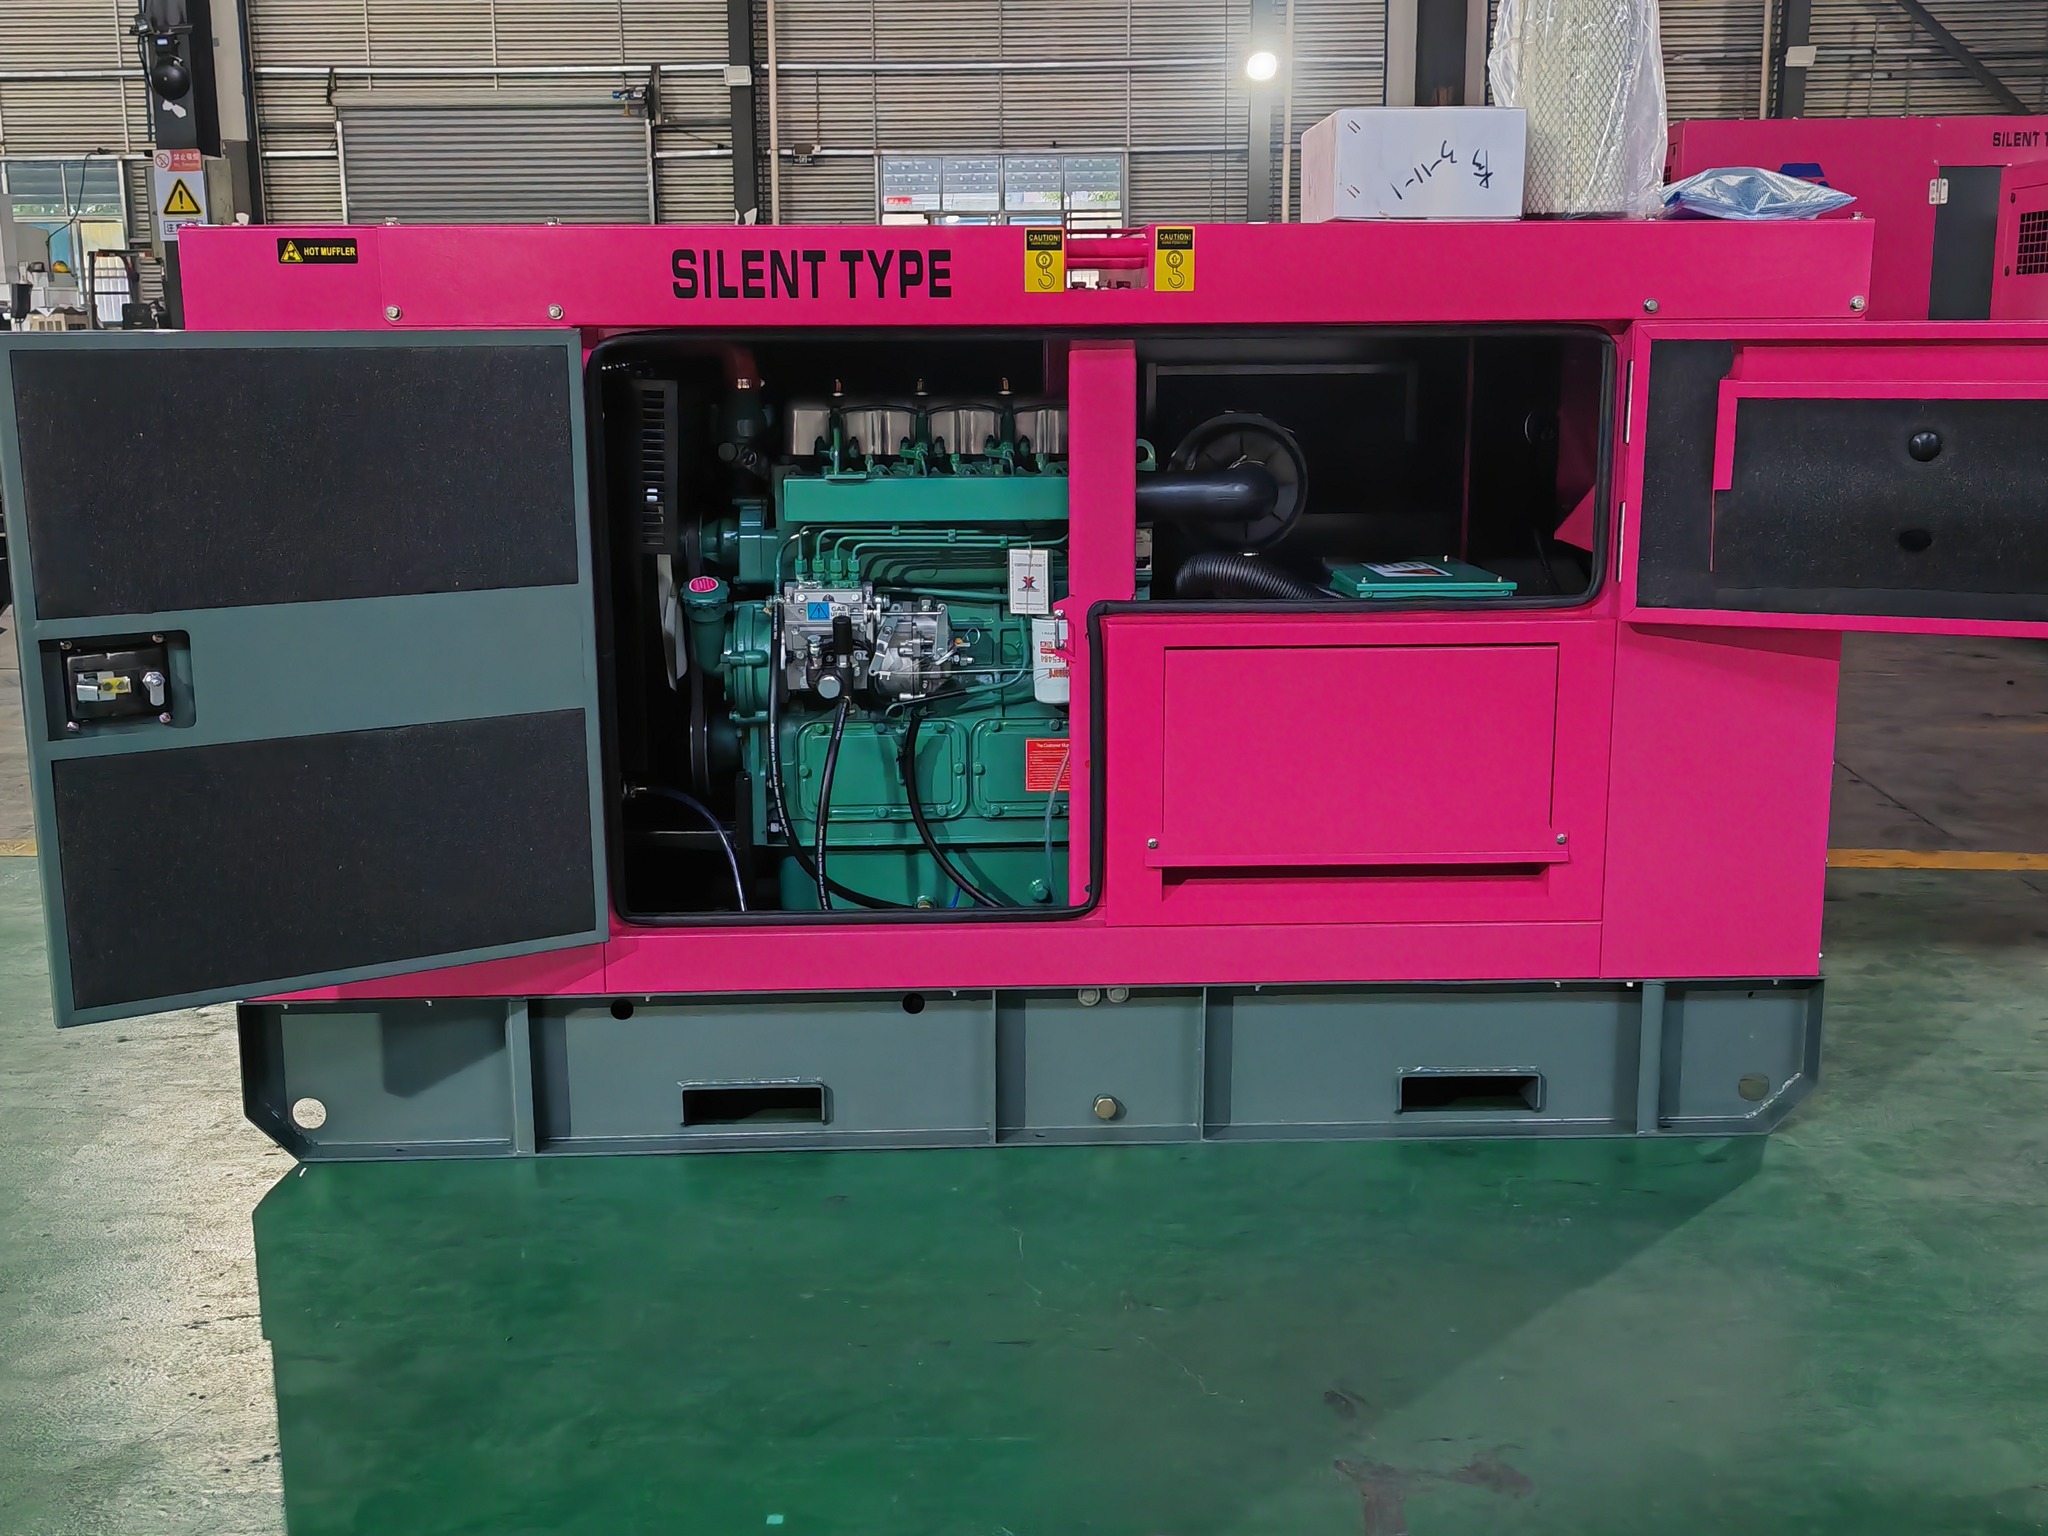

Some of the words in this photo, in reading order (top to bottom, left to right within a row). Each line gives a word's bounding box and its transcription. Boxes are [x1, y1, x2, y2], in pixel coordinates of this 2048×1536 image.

[1993, 132, 2040, 147] SILENT
[1029, 234, 1060, 242] CAUTION!
[1160, 233, 1191, 241] CAUTION!
[303, 247, 319, 256] HOT
[320, 247, 356, 256] MUFFLER
[672, 249, 826, 298] SILENT
[840, 249, 951, 298] TYPE
